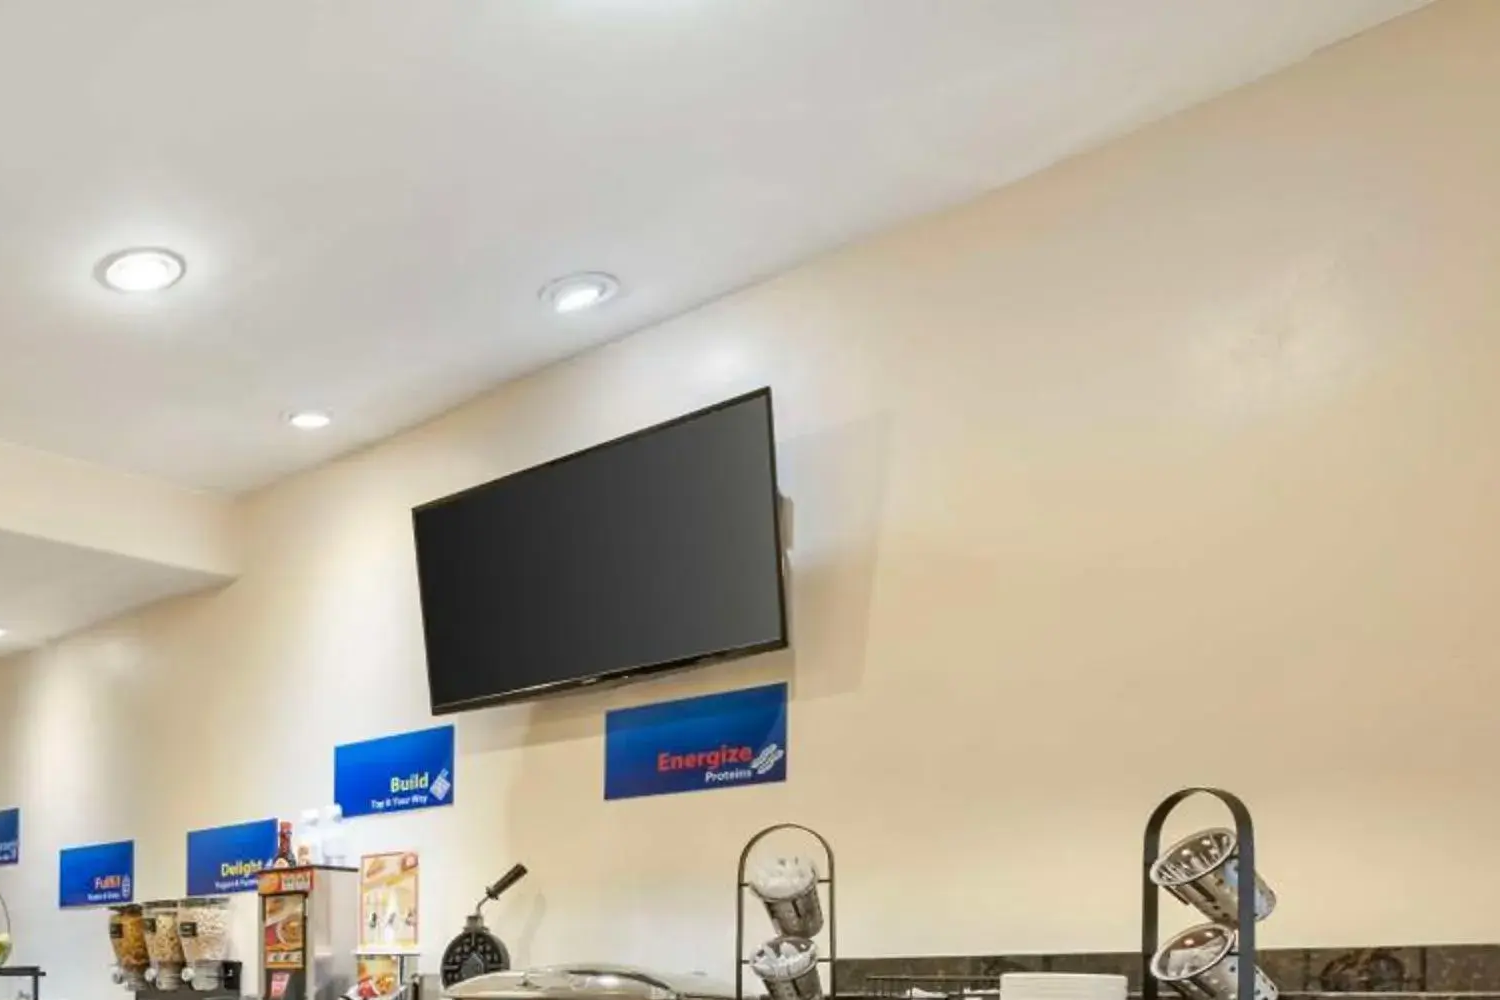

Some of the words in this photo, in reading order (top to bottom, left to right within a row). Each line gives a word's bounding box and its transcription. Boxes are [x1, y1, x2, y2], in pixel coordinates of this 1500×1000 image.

[657, 744, 753, 772] Energize
[391, 771, 429, 793] Build
[705, 767, 752, 783] Proteins
[221, 859, 262, 878] Delight
